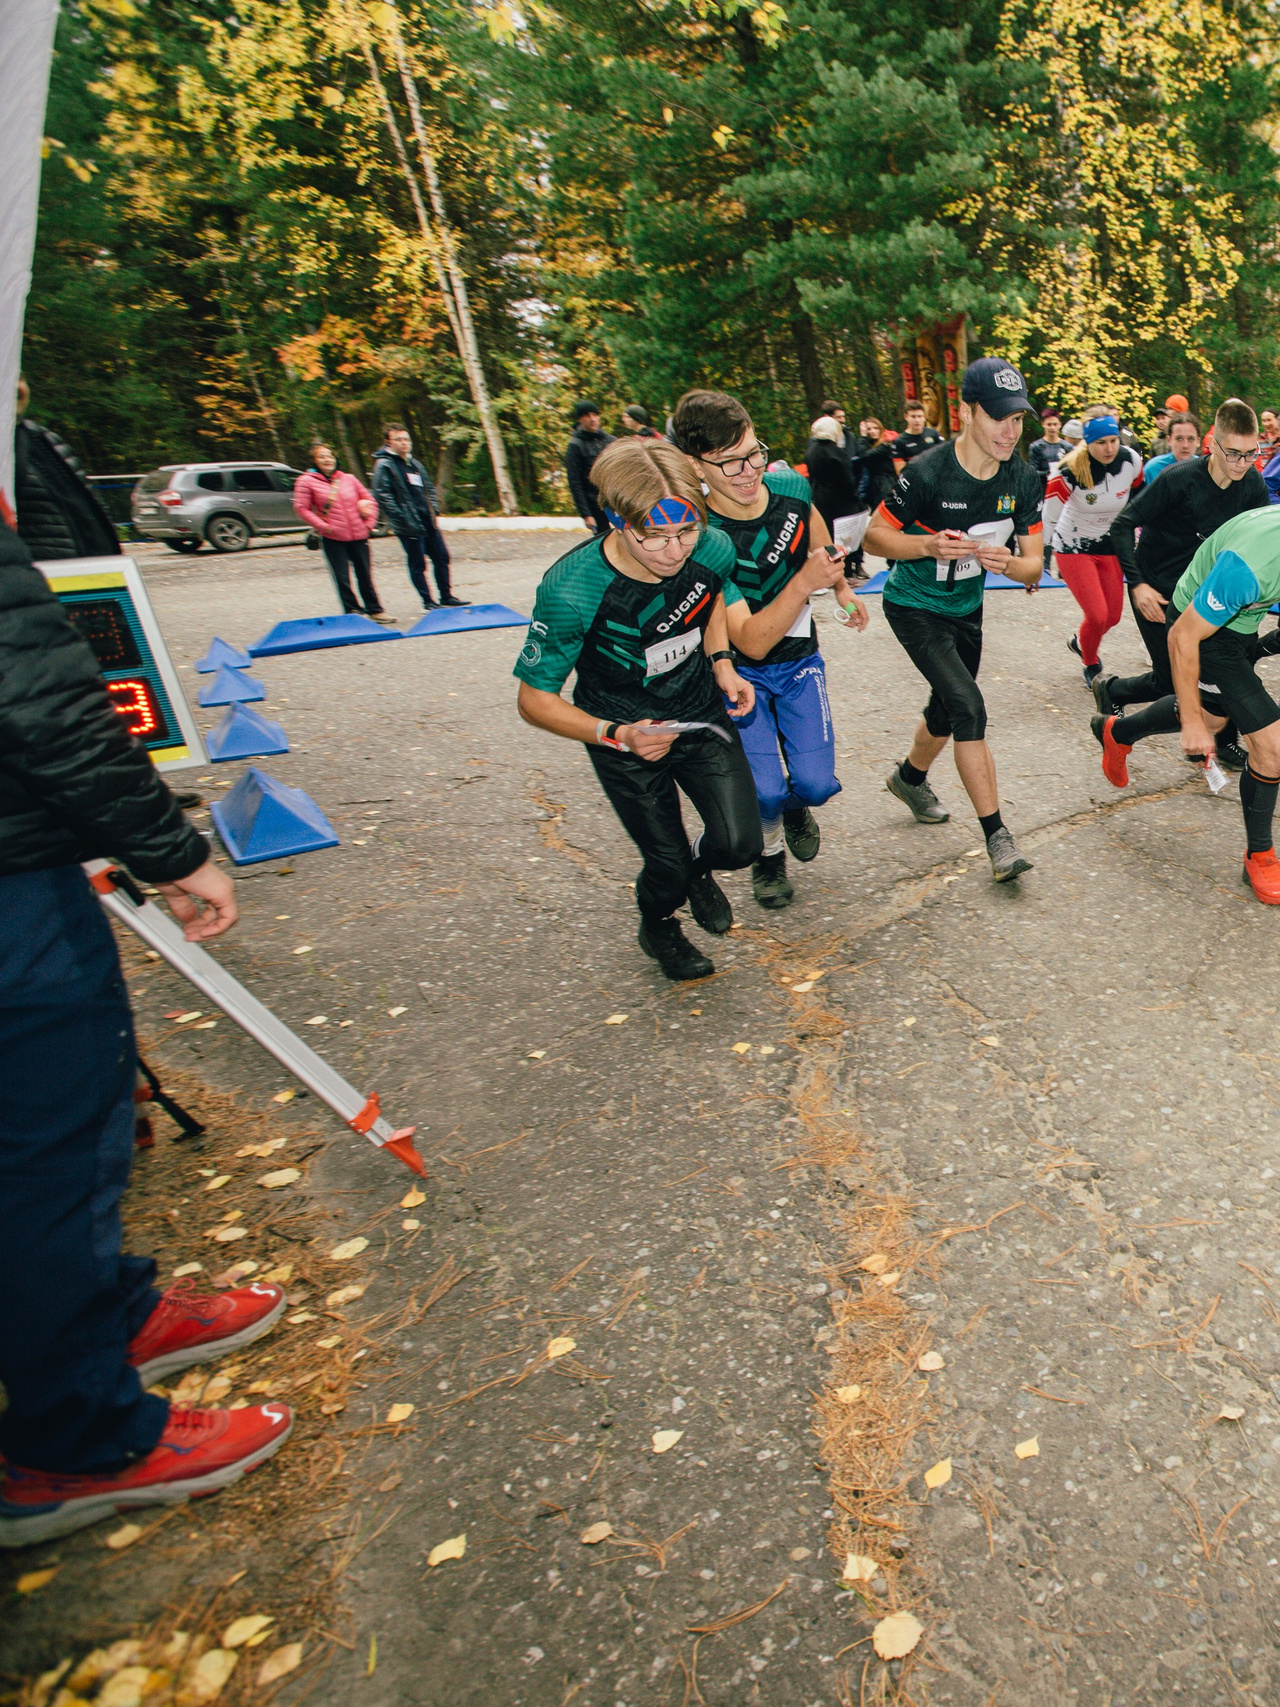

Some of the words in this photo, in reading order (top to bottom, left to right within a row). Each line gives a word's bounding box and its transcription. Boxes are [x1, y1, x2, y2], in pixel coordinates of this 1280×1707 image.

[941, 501, 968, 510] O-UGRA
[766, 511, 799, 565] O-UGRA
[956, 562, 971, 573] 09
[655, 581, 707, 634] O-UGRA
[664, 644, 687, 664] 114
